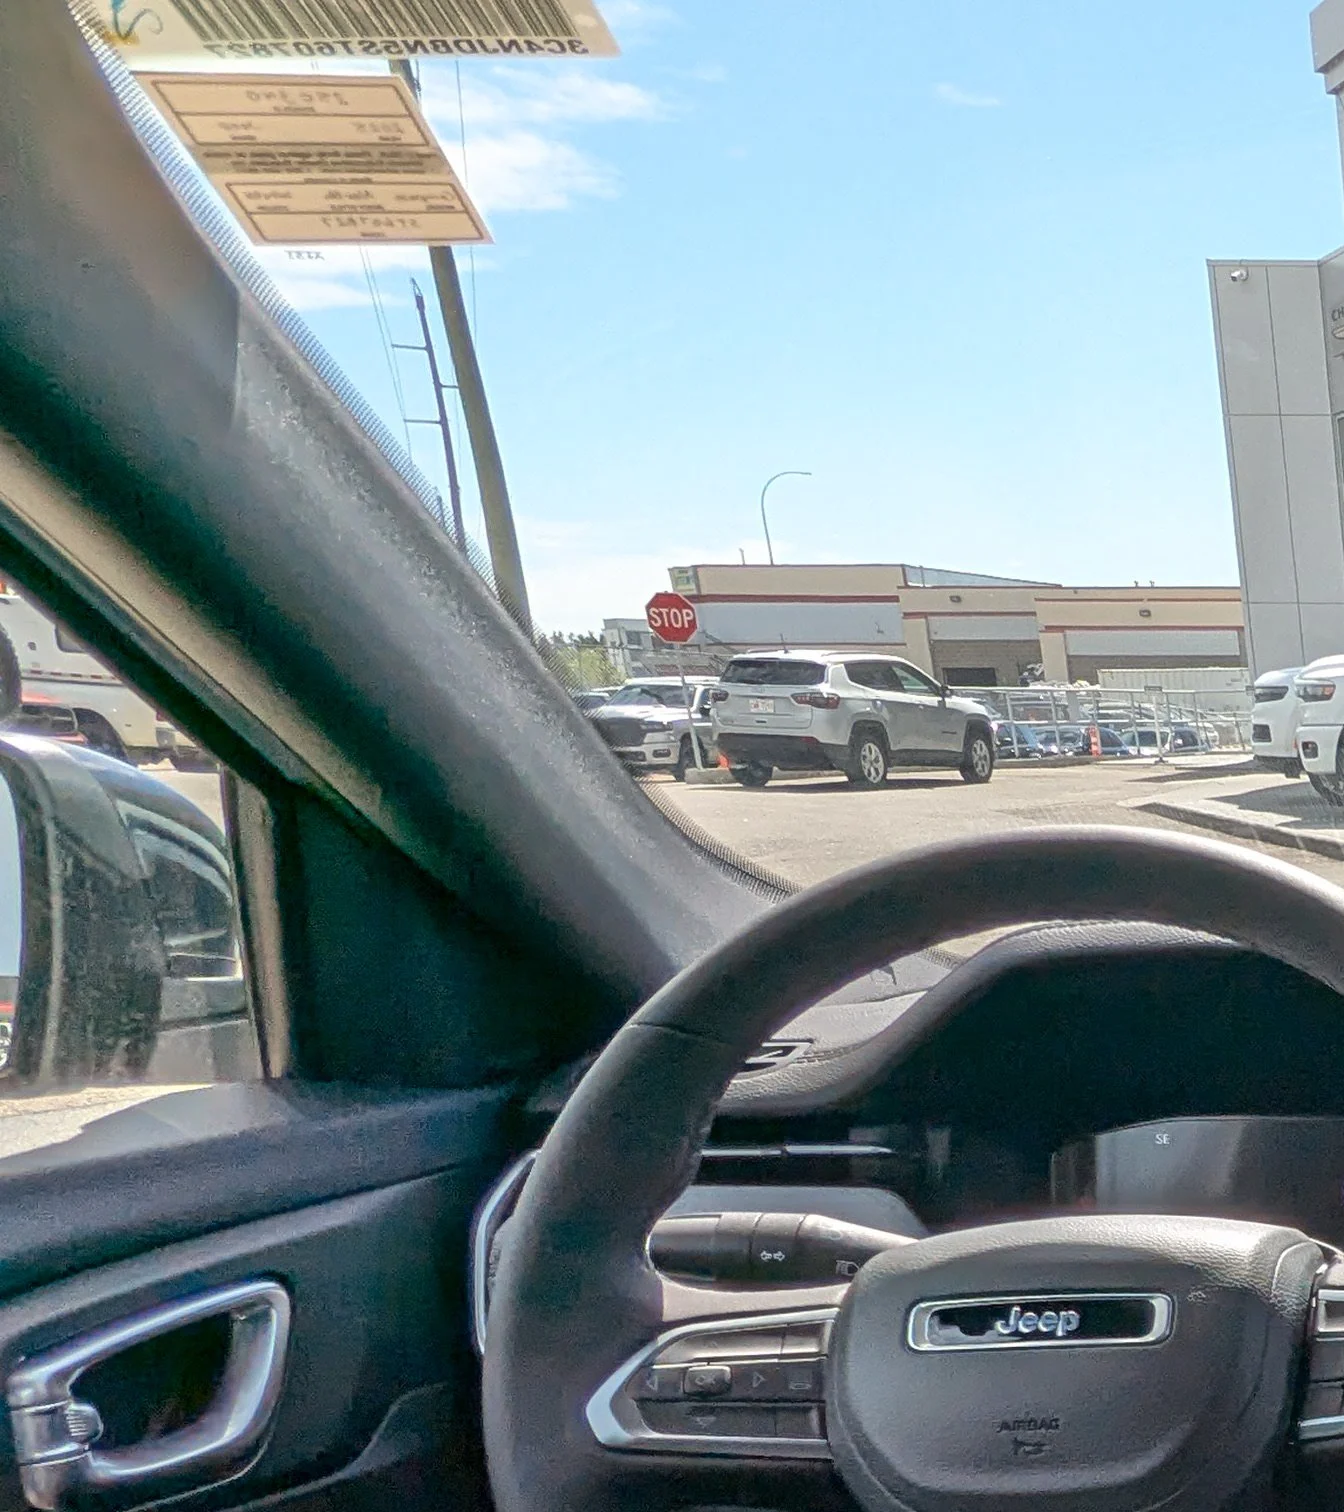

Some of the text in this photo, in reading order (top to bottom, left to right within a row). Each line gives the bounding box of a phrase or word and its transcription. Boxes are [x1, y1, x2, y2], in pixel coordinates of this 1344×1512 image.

[650, 607, 694, 628] STOP
[1155, 1133, 1171, 1145] SE
[994, 1305, 1080, 1337] Jeep
